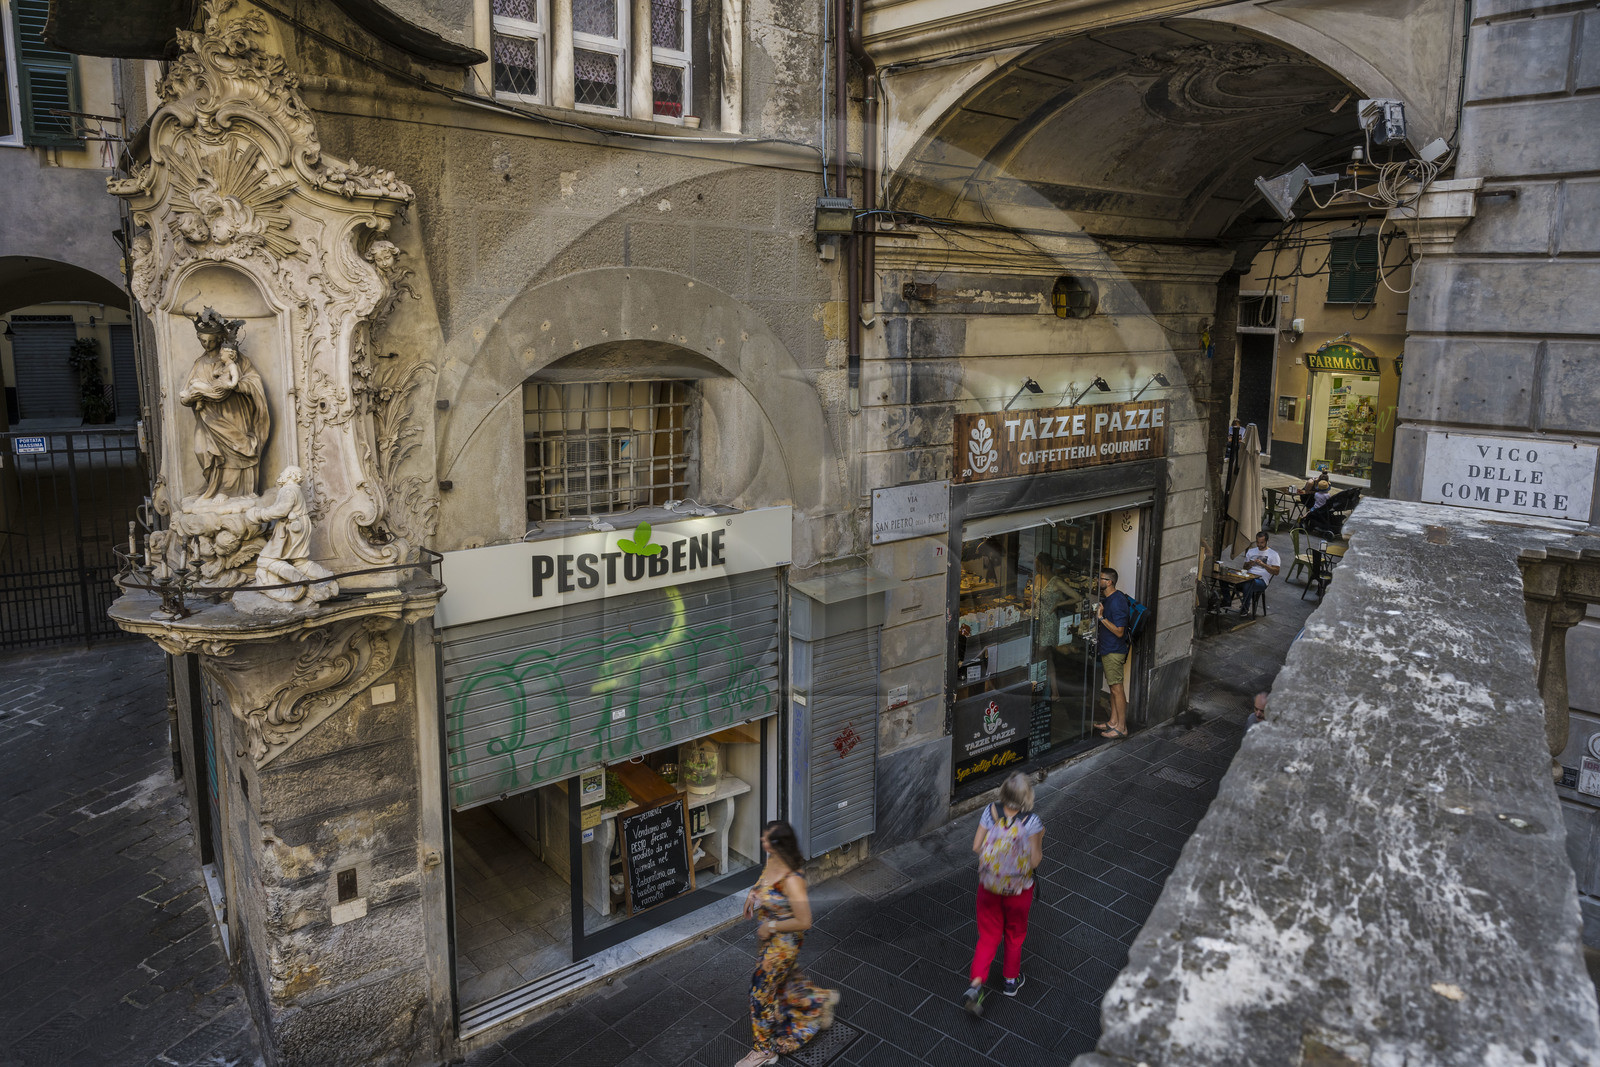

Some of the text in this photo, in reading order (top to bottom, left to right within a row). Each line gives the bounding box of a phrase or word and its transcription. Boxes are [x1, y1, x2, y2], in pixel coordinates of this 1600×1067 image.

[1308, 355, 1377, 372] FARMACIA
[1004, 406, 1165, 442] TAZZE PAZZE
[974, 455, 987, 467] TP
[1019, 438, 1151, 466] CAFFETTERIA GOURMET
[1476, 444, 1539, 463] VICO
[962, 469, 972, 477] 20
[1467, 464, 1543, 485] DELLE
[1441, 482, 1569, 512] COMPERE
[875, 522, 889, 532] SAN
[891, 517, 914, 530] PIETRO
[928, 512, 947, 523] PORTA
[936, 547, 943, 556] 71
[531, 528, 726, 598] PESTOBENE
[965, 727, 1016, 751] TAZZE PAZZE
[991, 750, 1017, 766] Coffee
[633, 817, 672, 839] Vendiamo solo
[630, 839, 647, 854] PESTO
[656, 843, 663, 853] da
[664, 840, 672, 849] noi
[673, 838, 679, 846] in
[658, 851, 668, 864] nel
[656, 878, 675, 892] appena
